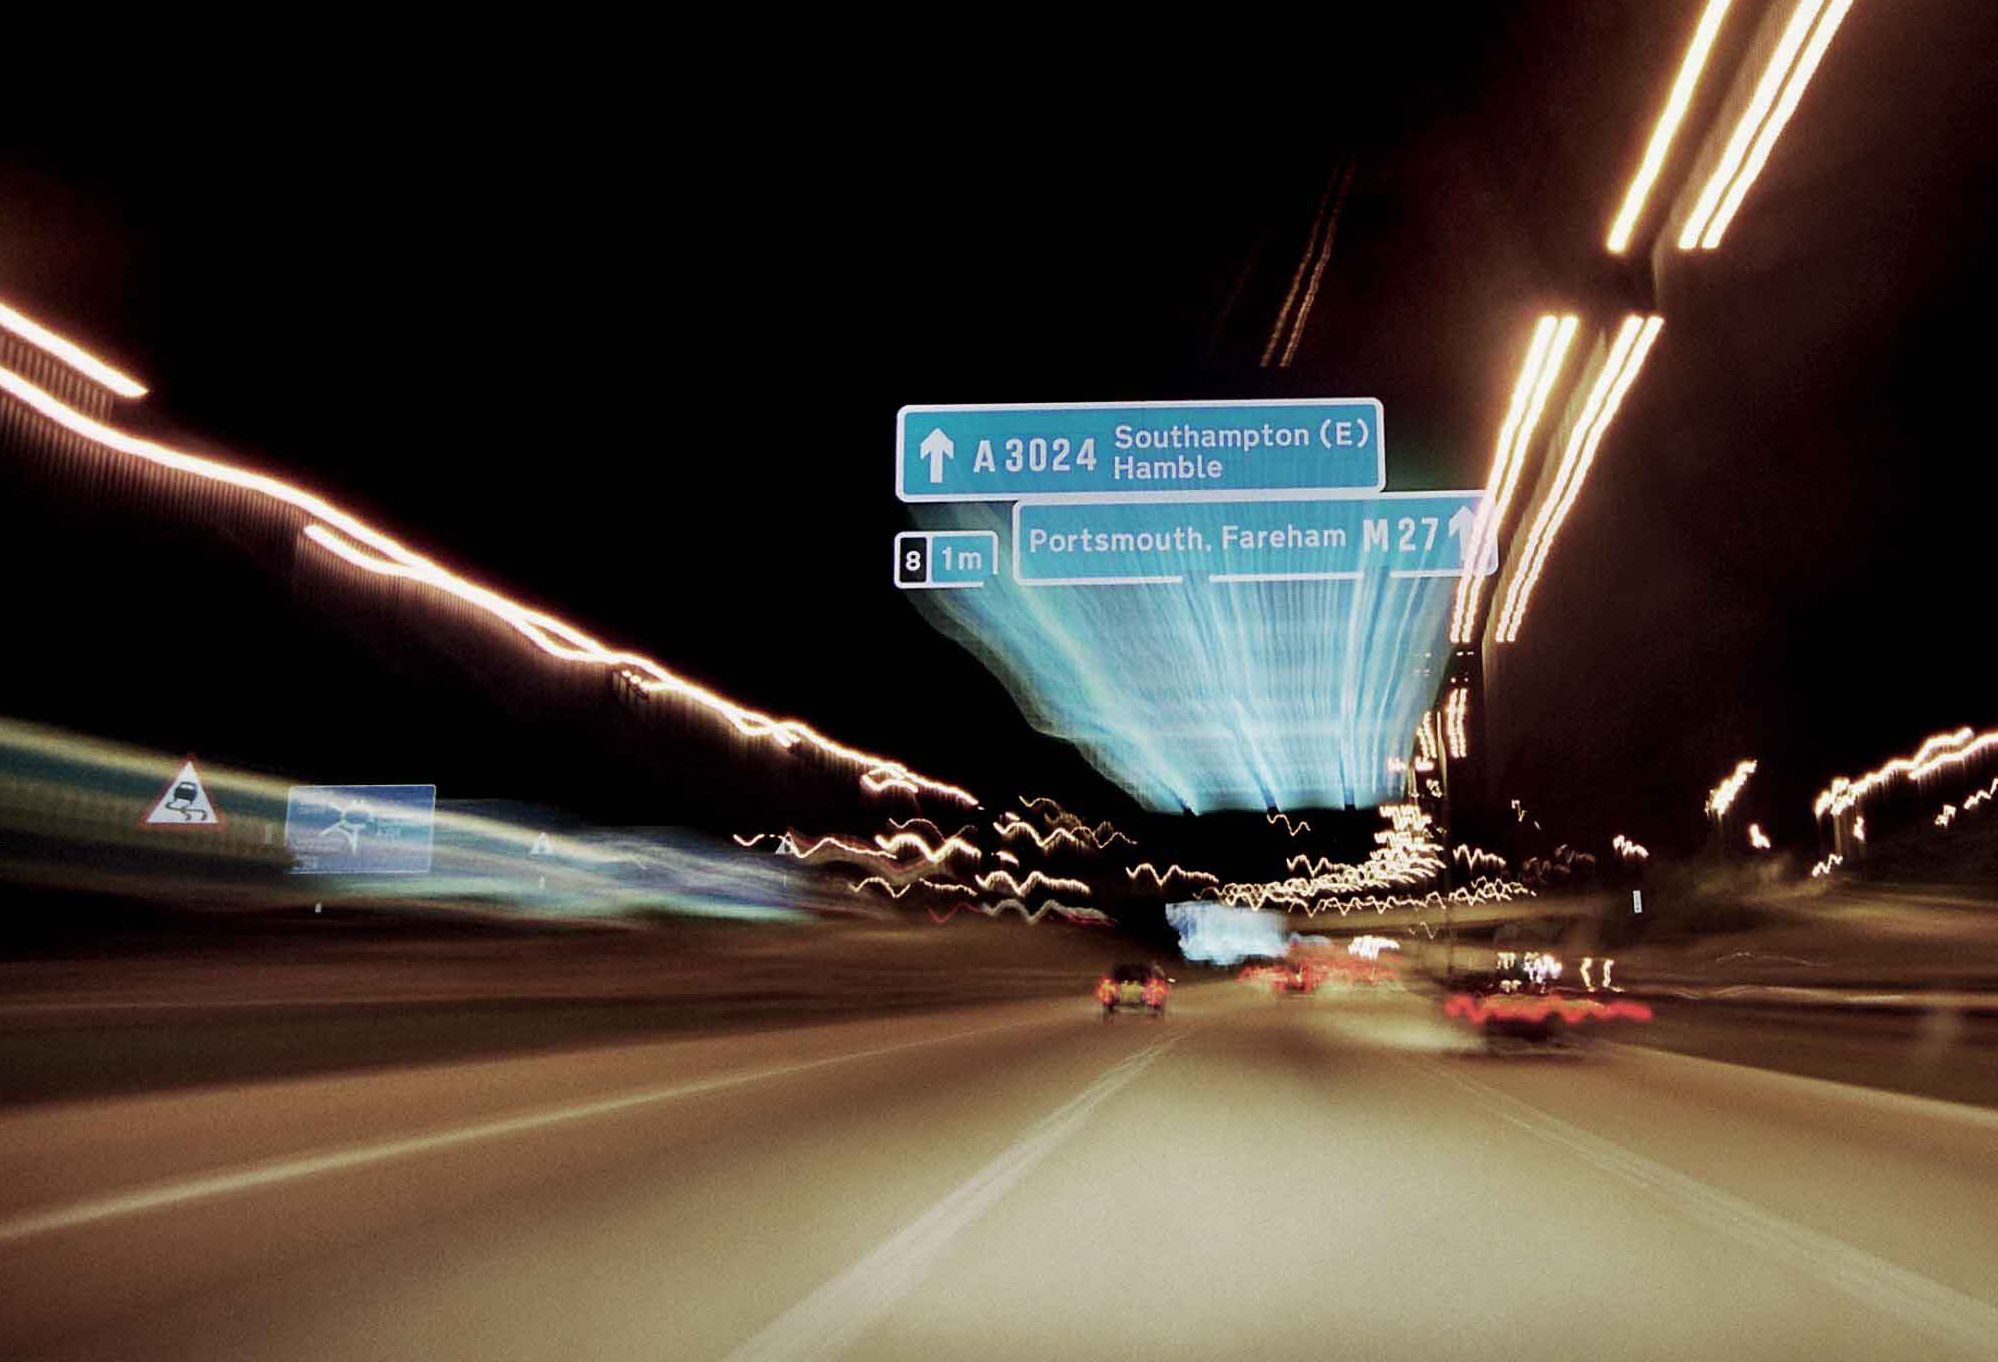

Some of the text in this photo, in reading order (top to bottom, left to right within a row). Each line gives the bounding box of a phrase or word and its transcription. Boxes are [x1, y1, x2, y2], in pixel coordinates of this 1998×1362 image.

[1114, 420, 1369, 452] Southampton (E)
[1114, 455, 1223, 479] Hamble
[1222, 525, 1346, 550] Fareham
[905, 546, 982, 571] 8 1m
